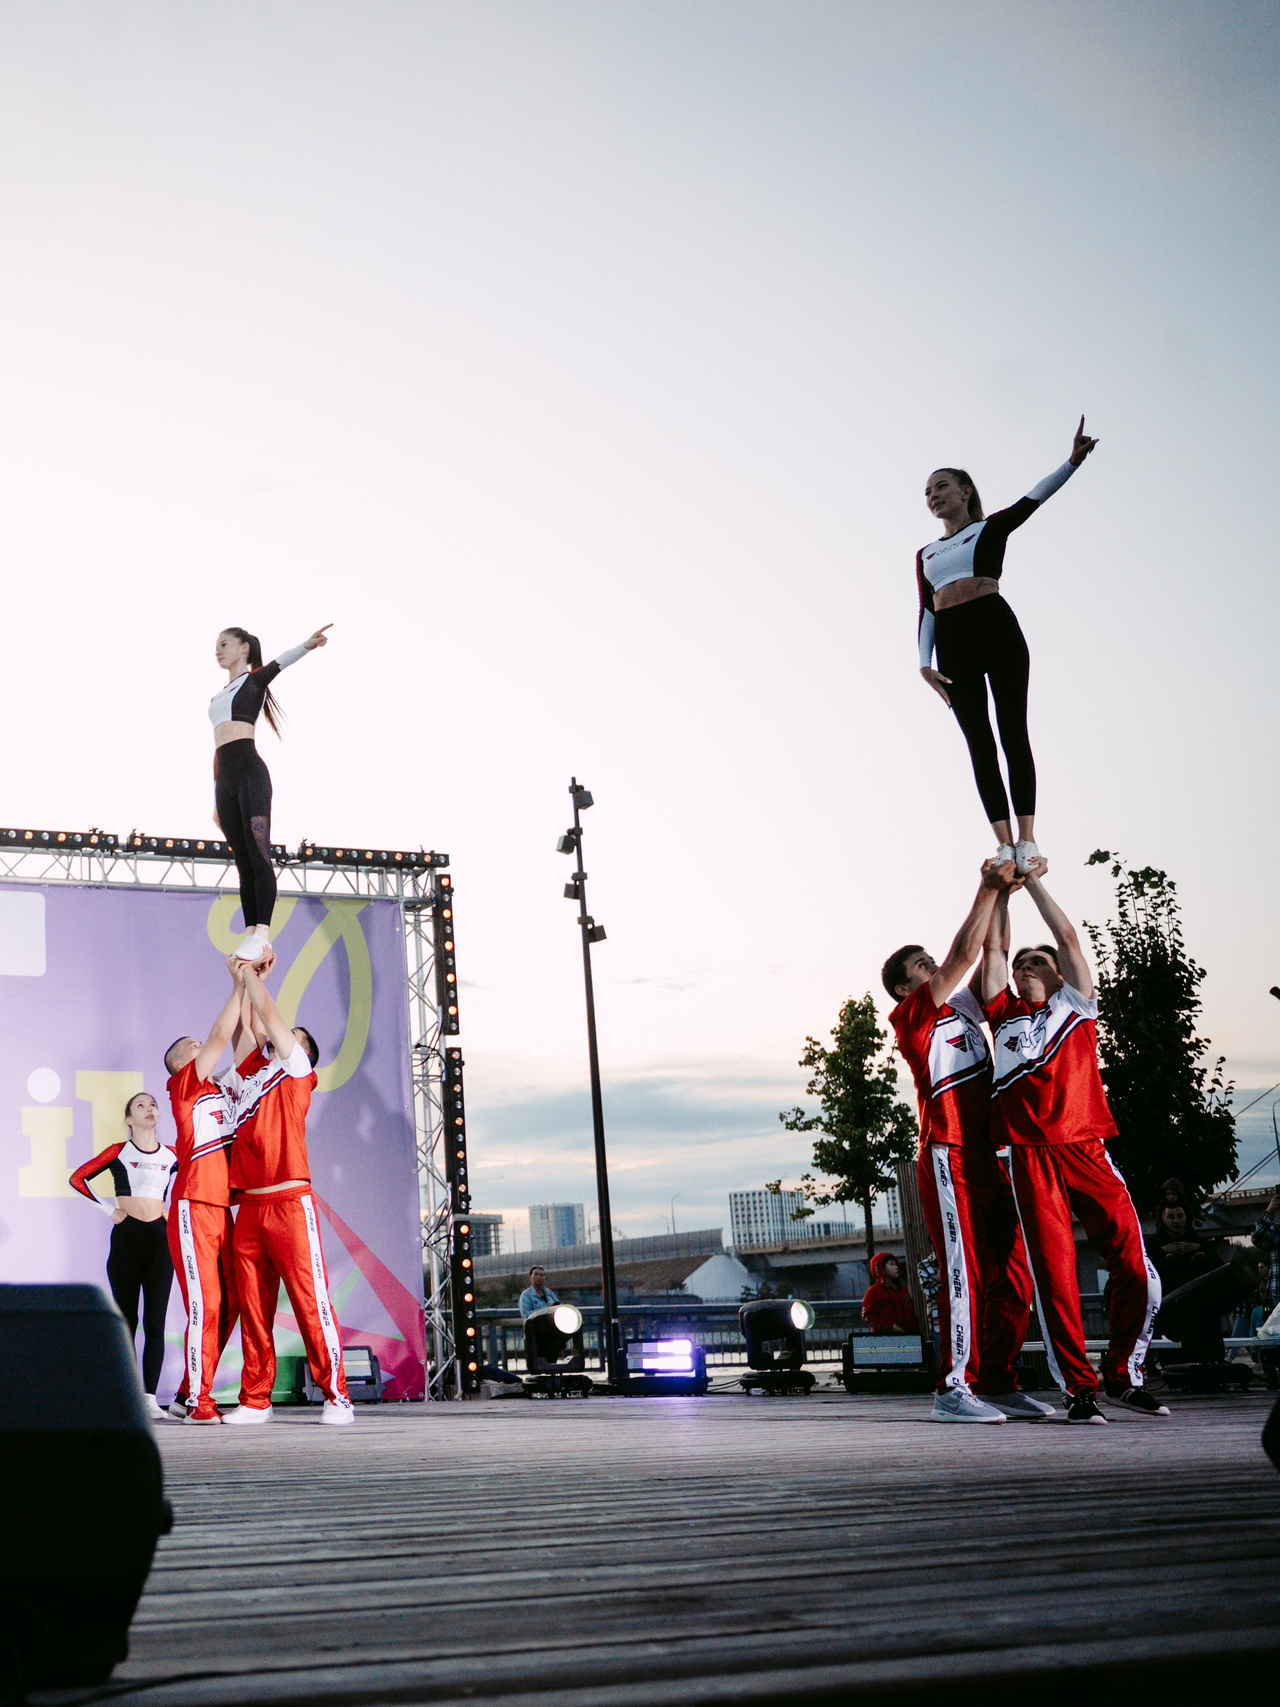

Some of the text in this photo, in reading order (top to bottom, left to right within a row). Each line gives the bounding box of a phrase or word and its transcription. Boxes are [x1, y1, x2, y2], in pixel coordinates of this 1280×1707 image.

[946, 1211, 957, 1243] CHEER
[186, 1254, 195, 1280] CHEER
[953, 1268, 962, 1299] CHEER
[320, 1301, 330, 1327] CHEER
[956, 1323, 964, 1356] CHEER
